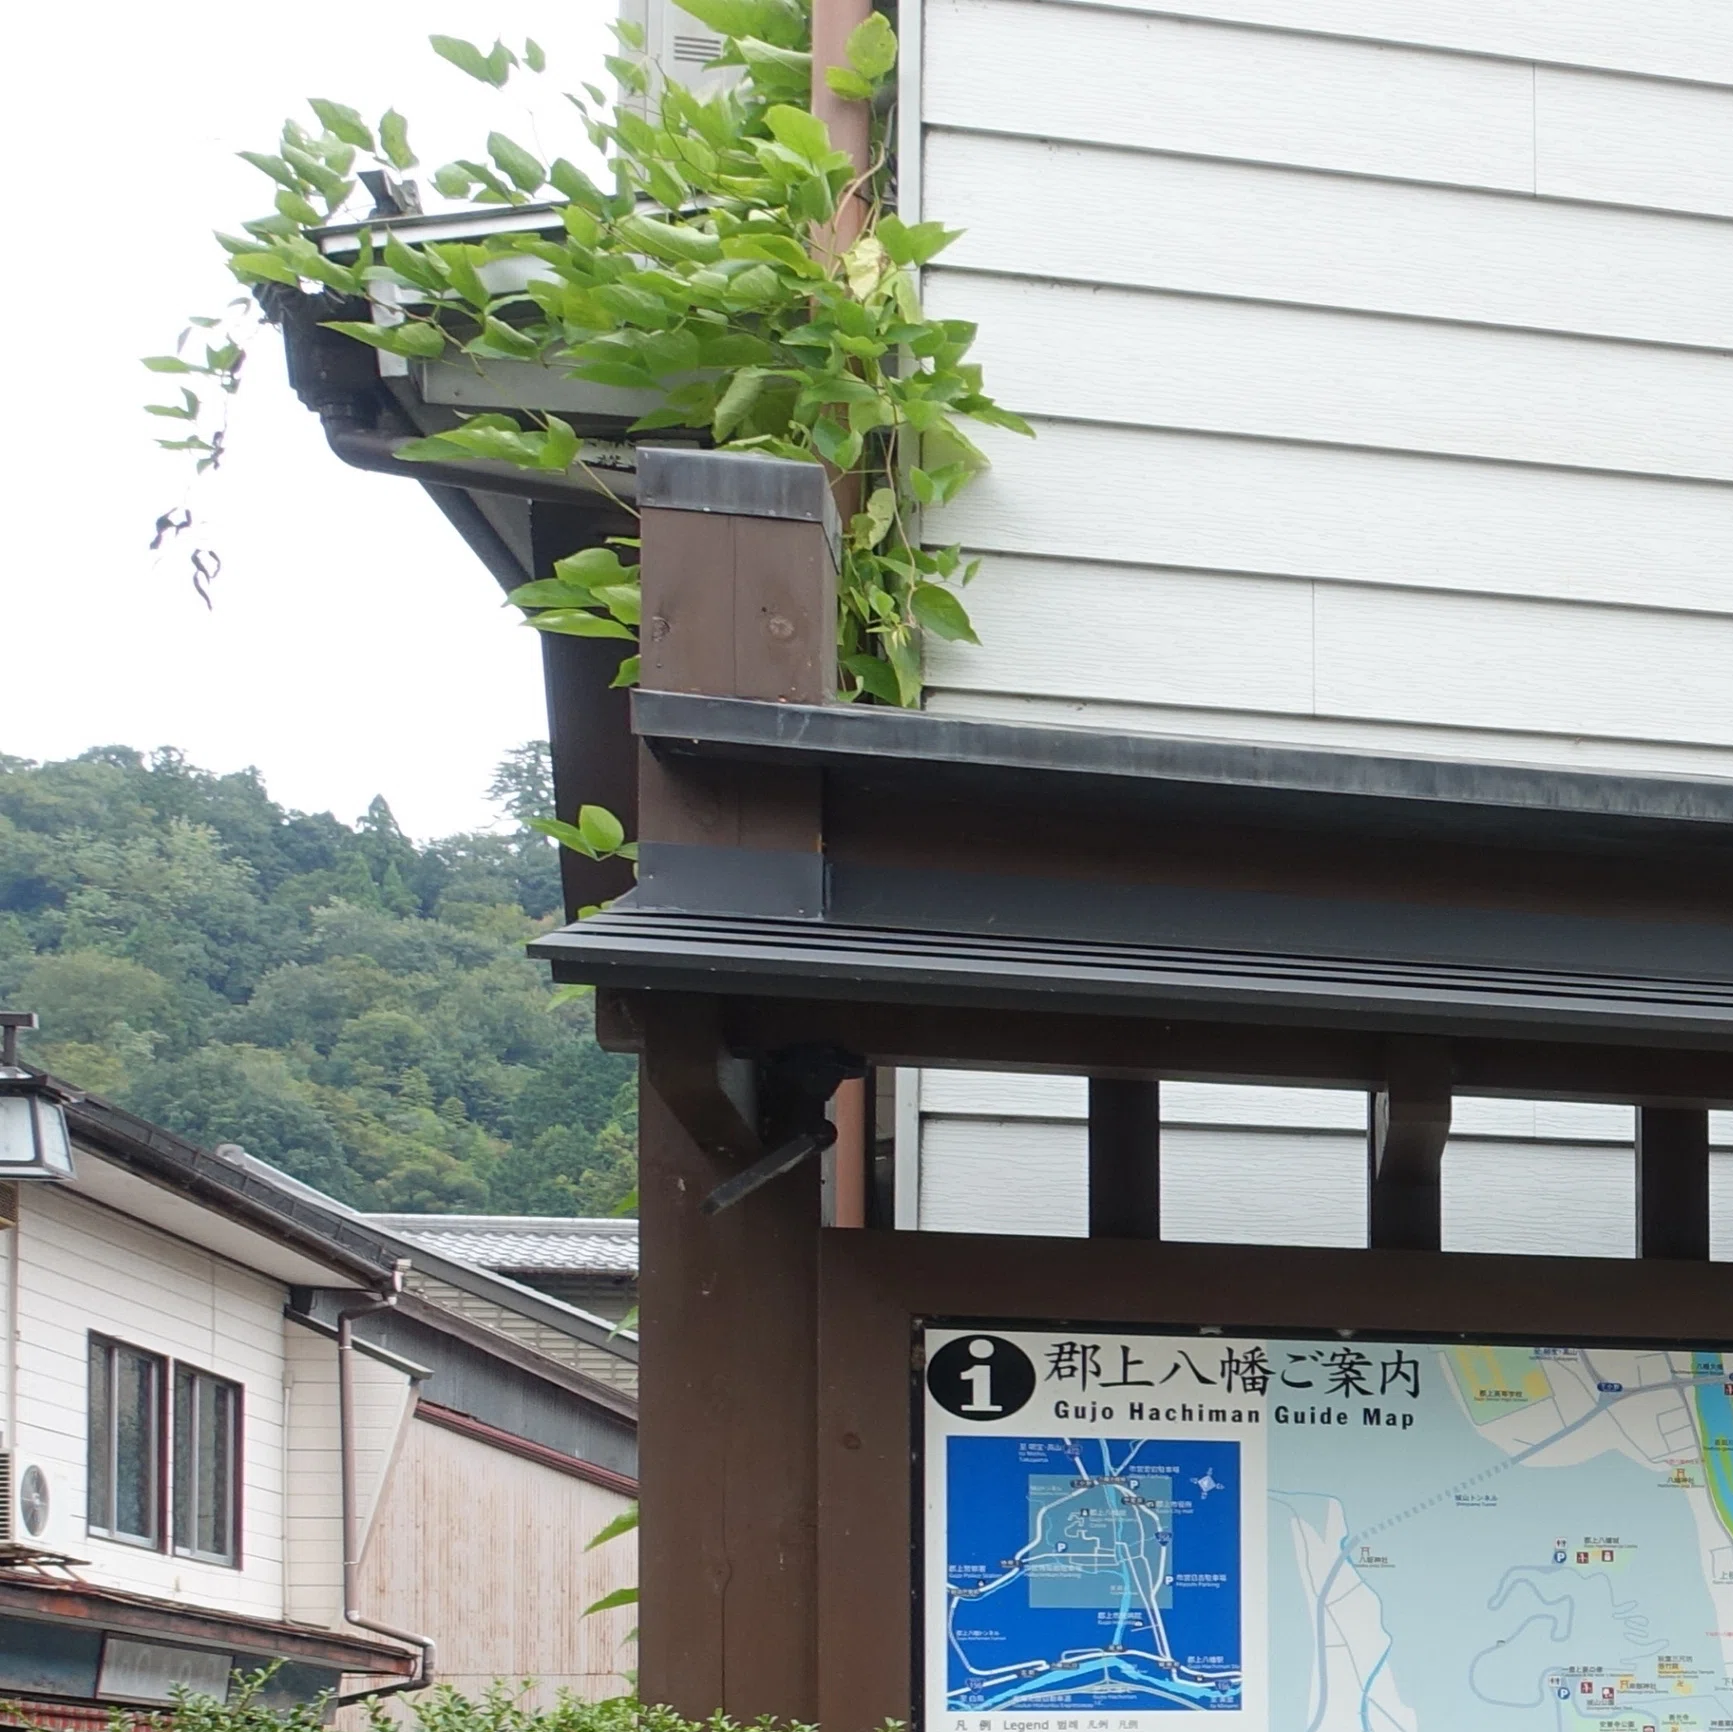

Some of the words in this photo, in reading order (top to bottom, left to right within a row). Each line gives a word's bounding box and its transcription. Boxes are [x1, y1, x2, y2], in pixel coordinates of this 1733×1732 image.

[1044, 1341, 1420, 1398] 郡上八幡ご案内
[1054, 1400, 1114, 1421] Gujo
[1129, 1403, 1261, 1424] Hachiman
[1274, 1406, 1349, 1426] Guide
[1362, 1408, 1415, 1430] Map
[1003, 1720, 1049, 1732] Legend
